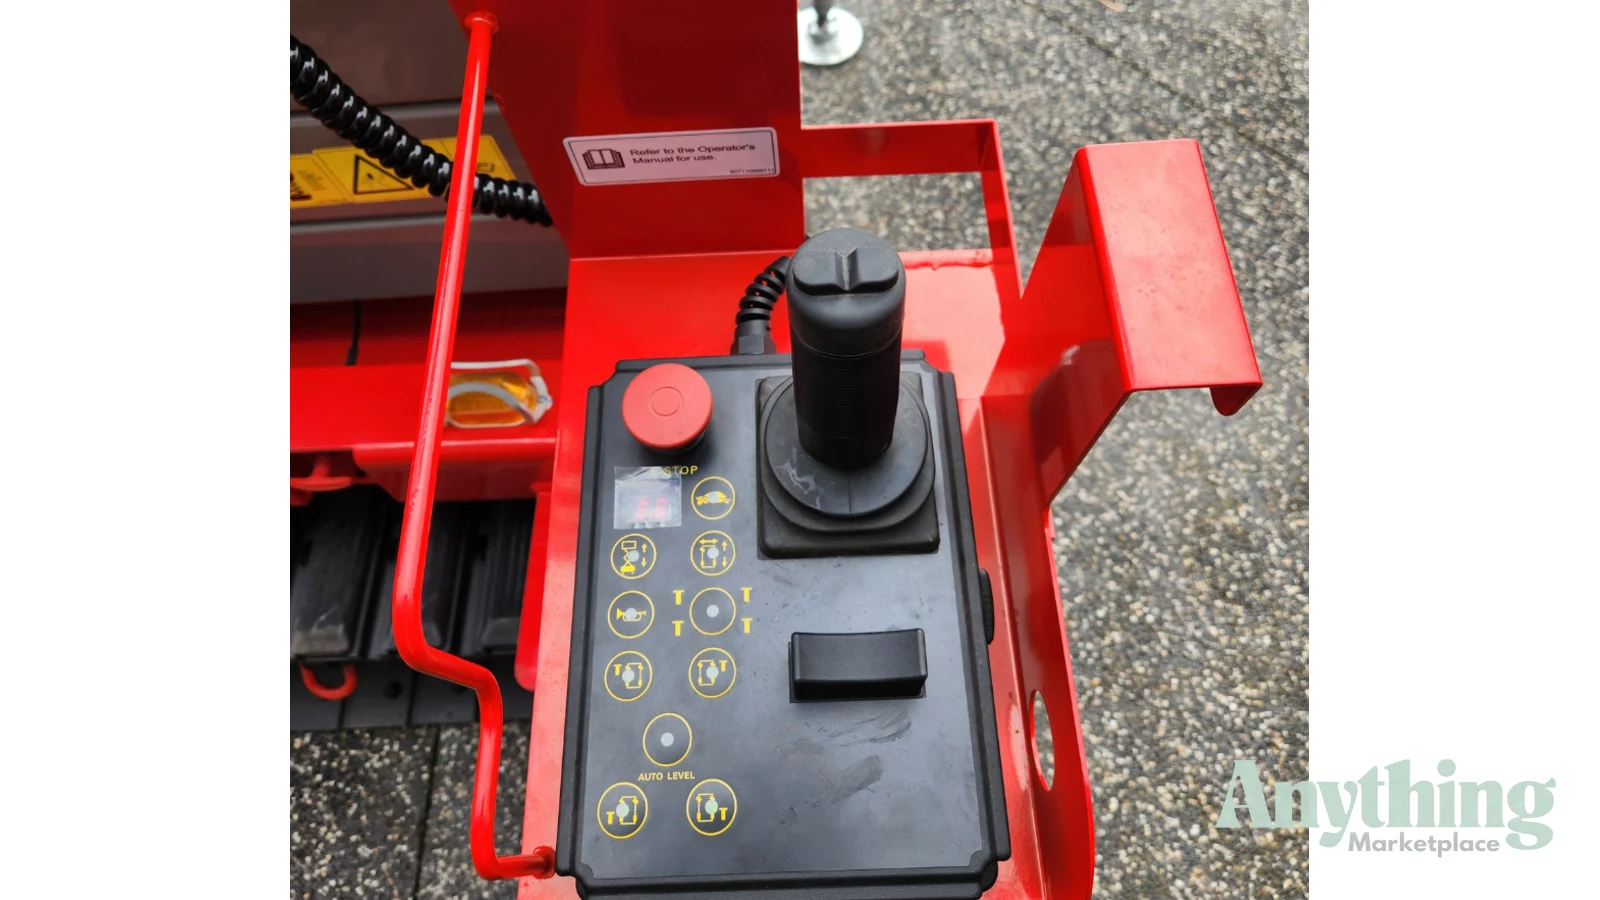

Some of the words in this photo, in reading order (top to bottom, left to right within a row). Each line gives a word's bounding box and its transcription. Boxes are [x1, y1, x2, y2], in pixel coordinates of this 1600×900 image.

[630, 148, 661, 156] Refer
[698, 144, 756, 153] Operator's
[633, 156, 674, 164] Manual
[694, 154, 717, 162] use.
[638, 772, 663, 781] AUTO
[668, 771, 695, 780] LEVEL
